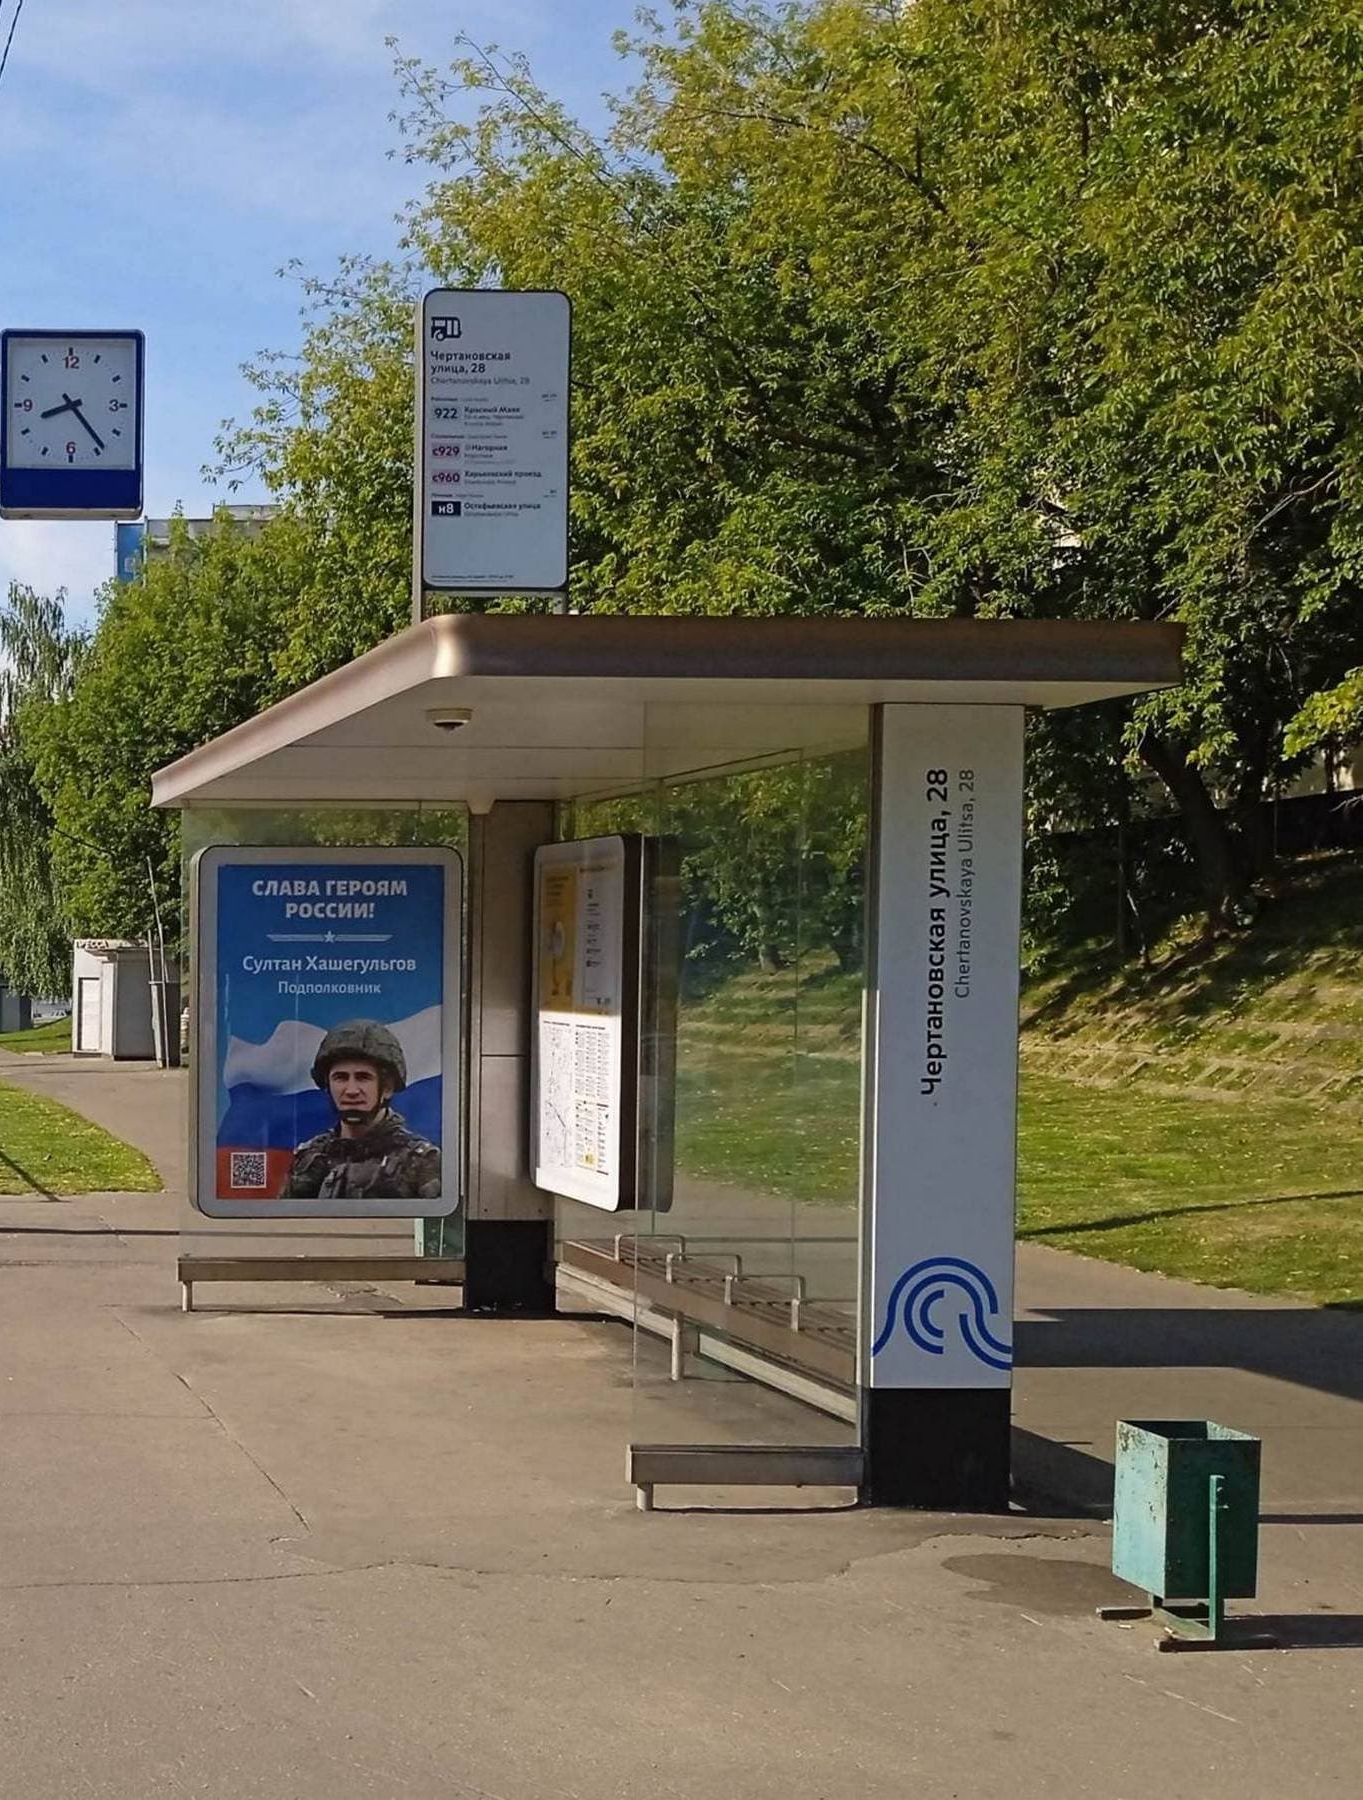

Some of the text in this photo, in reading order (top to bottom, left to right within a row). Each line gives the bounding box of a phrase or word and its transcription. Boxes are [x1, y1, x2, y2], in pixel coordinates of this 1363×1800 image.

[63, 356, 79, 369] 12
[430, 351, 511, 363] Чертановская
[430, 363, 486, 375] улица, 28
[23, 399, 33, 411] 9
[109, 399, 119, 412] 3
[434, 408, 458, 419] 922
[65, 441, 77, 455] 6
[251, 880, 408, 896] СЛАВА ГЕРОЯМ
[954, 769, 976, 999] Chertanovskaya Ulitsa, 28
[285, 902, 375, 919] РОССИИ!
[921, 768, 952, 1096] Чертановская улица, 28
[242, 955, 417, 975] Султан Хашегульгов
[278, 980, 382, 996] Подполковник
